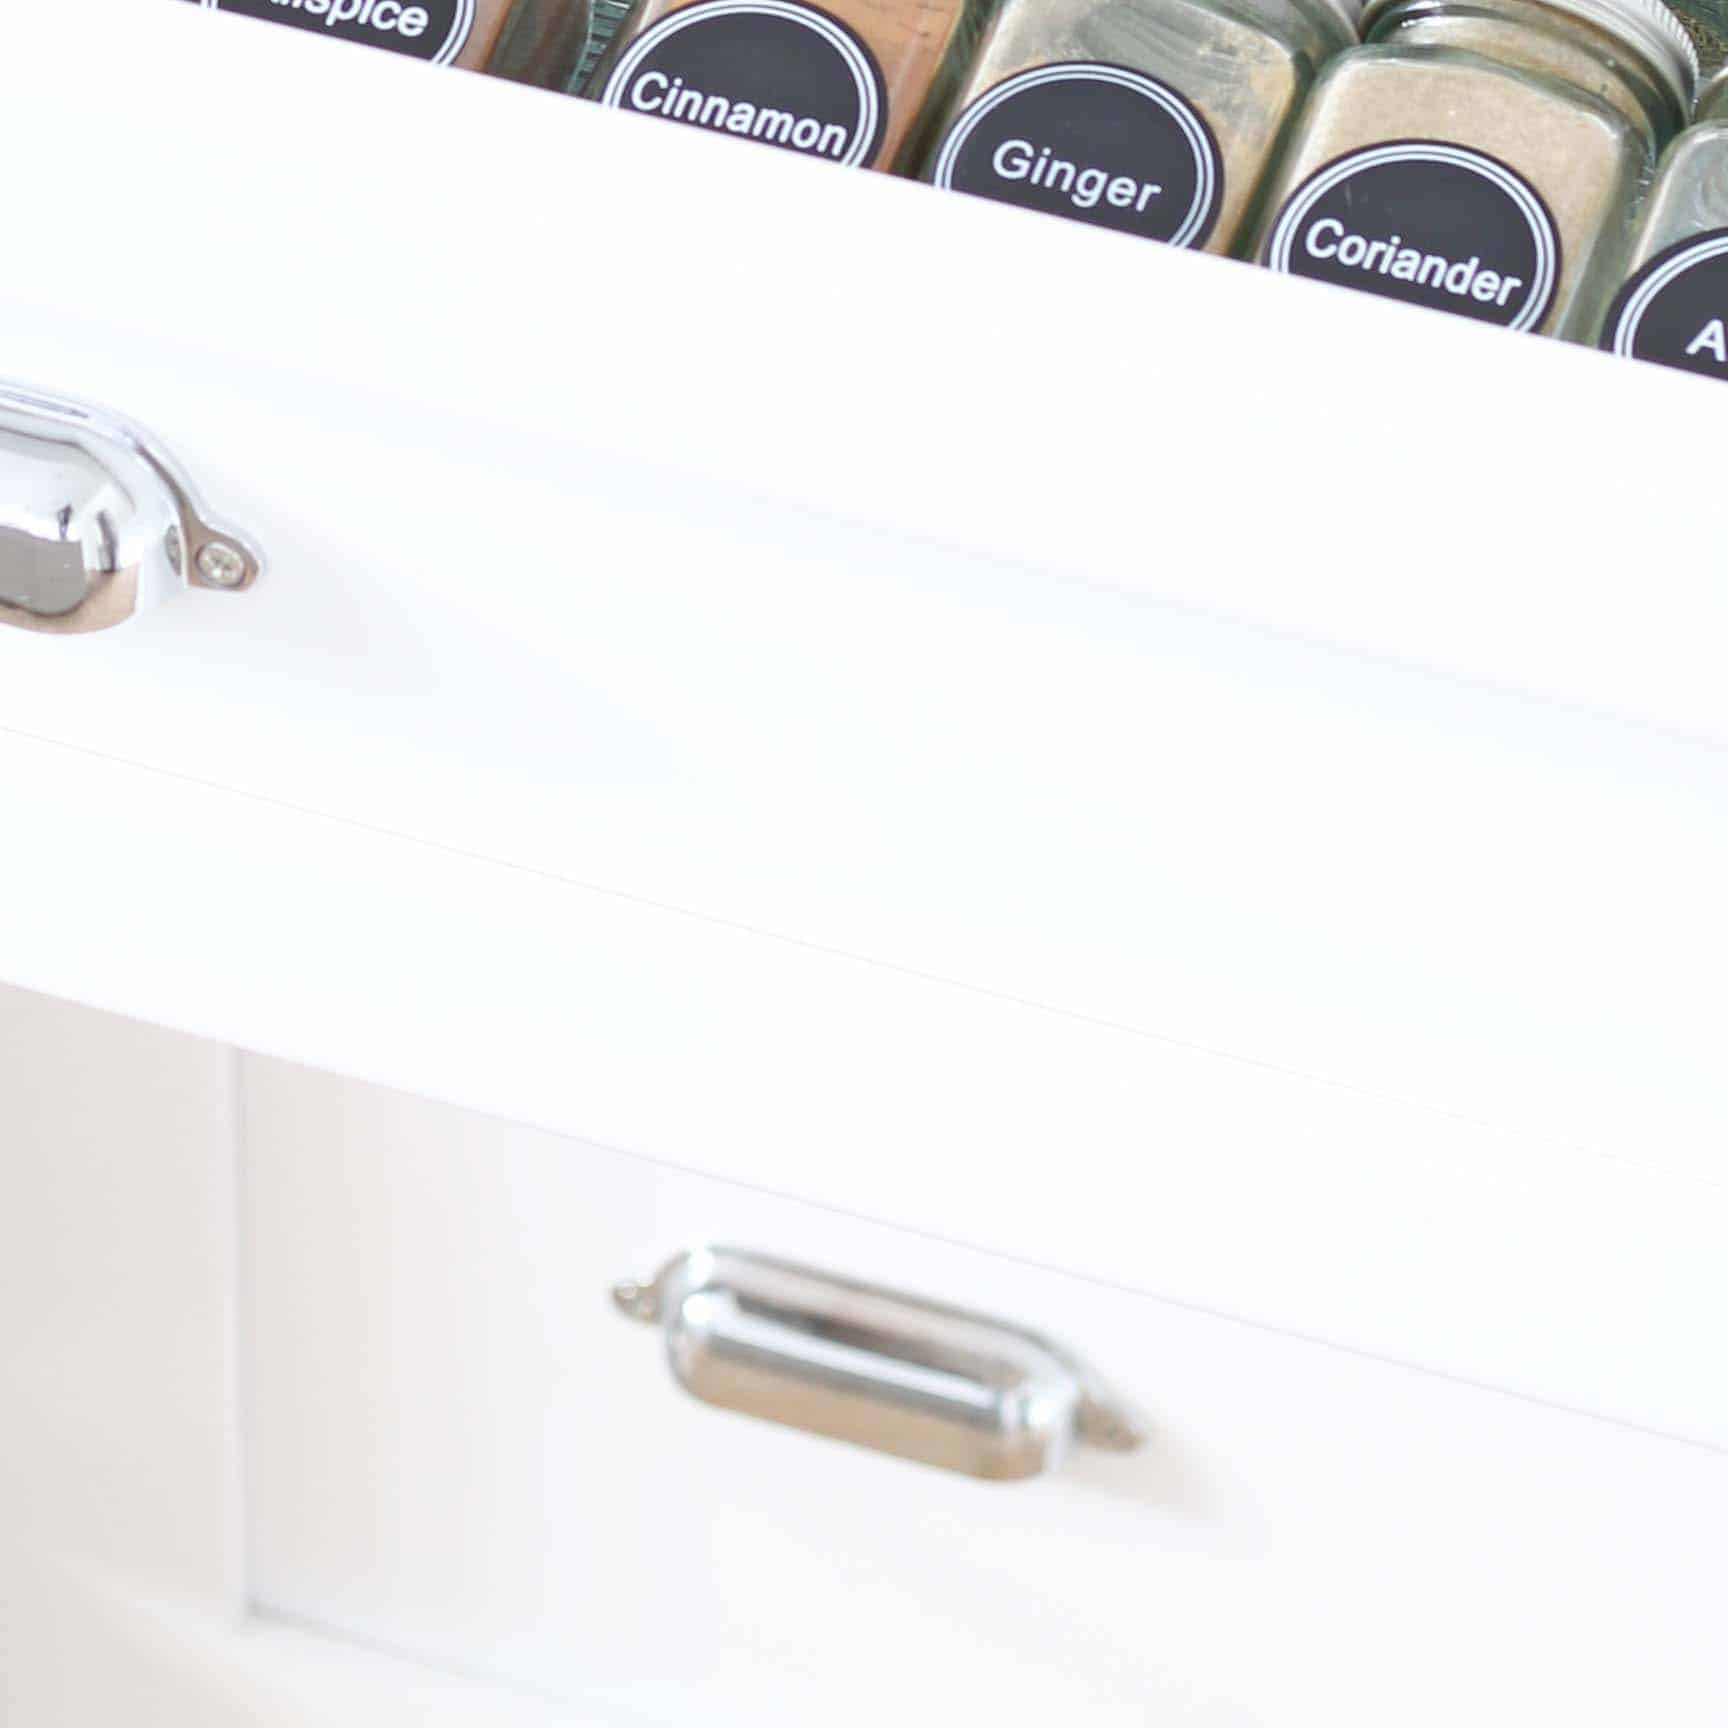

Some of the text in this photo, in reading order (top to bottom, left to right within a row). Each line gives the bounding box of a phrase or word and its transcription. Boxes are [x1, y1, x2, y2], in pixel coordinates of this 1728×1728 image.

[631, 71, 847, 156] Cinnamon
[993, 139, 1162, 212] Ginger
[1305, 218, 1523, 306] Coriander
